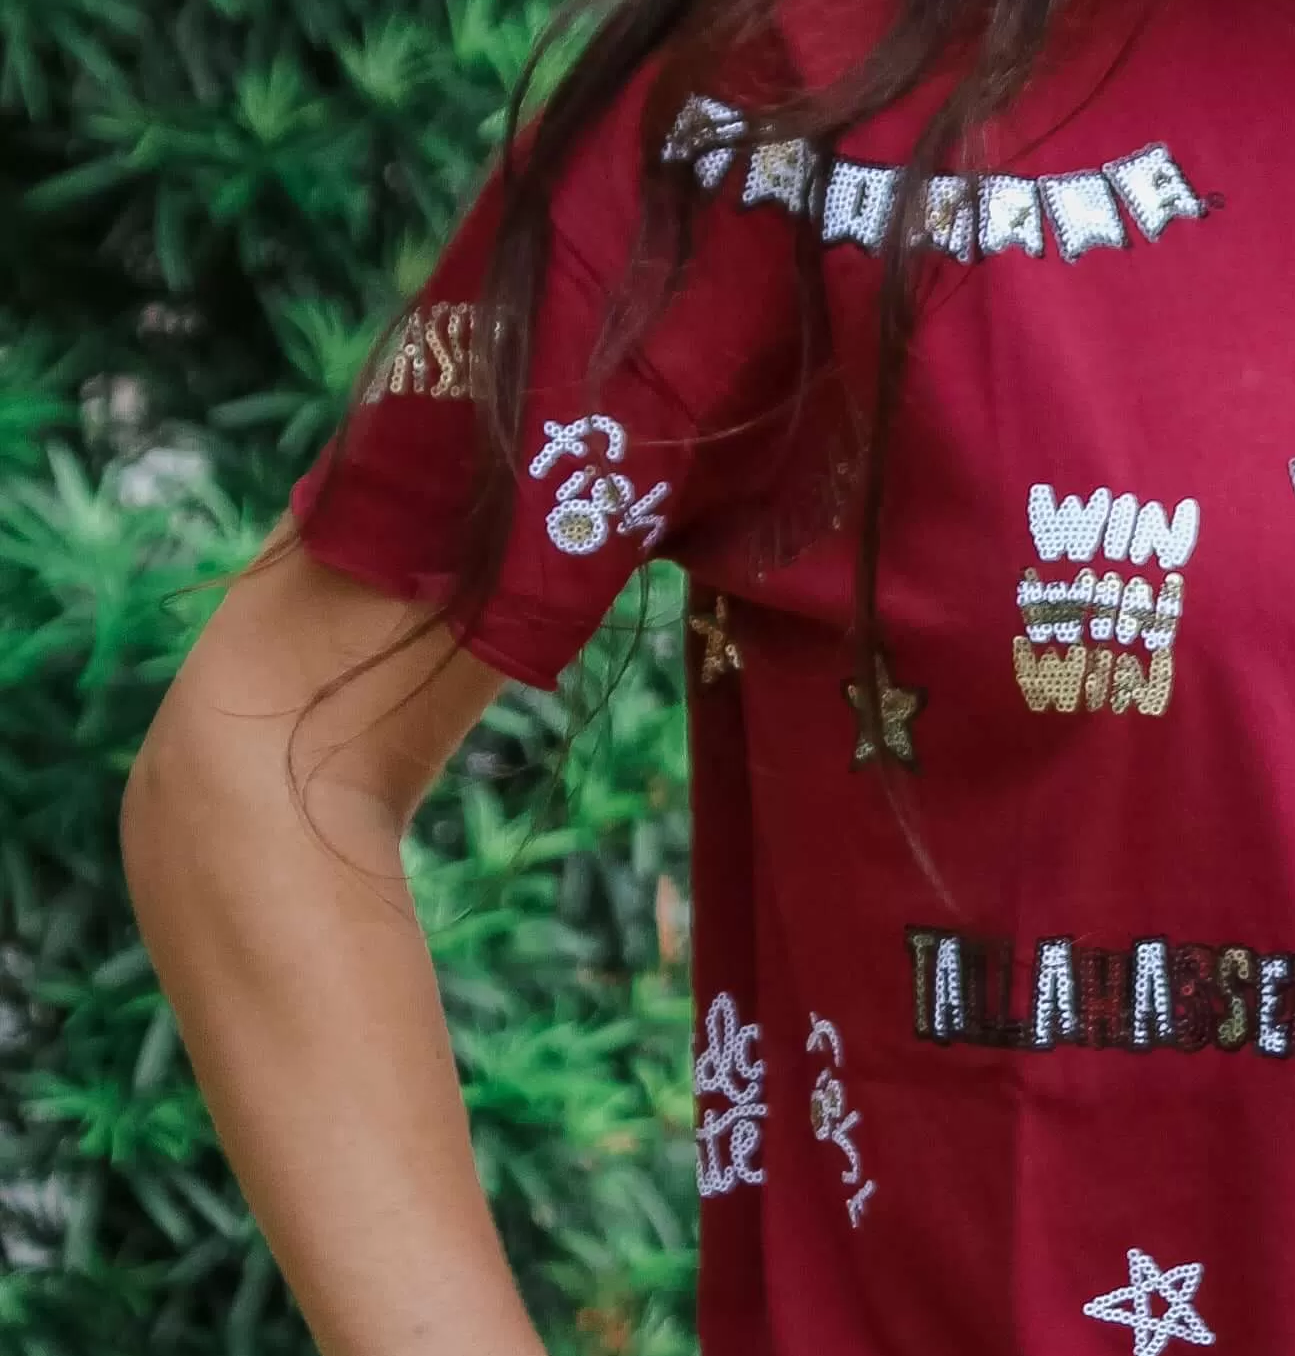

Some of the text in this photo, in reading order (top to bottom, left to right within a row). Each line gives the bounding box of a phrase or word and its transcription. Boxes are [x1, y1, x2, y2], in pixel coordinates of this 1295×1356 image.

[1028, 483, 1200, 569] WIN
[1016, 567, 1184, 650] WIN
[1012, 636, 1176, 716] WIN
